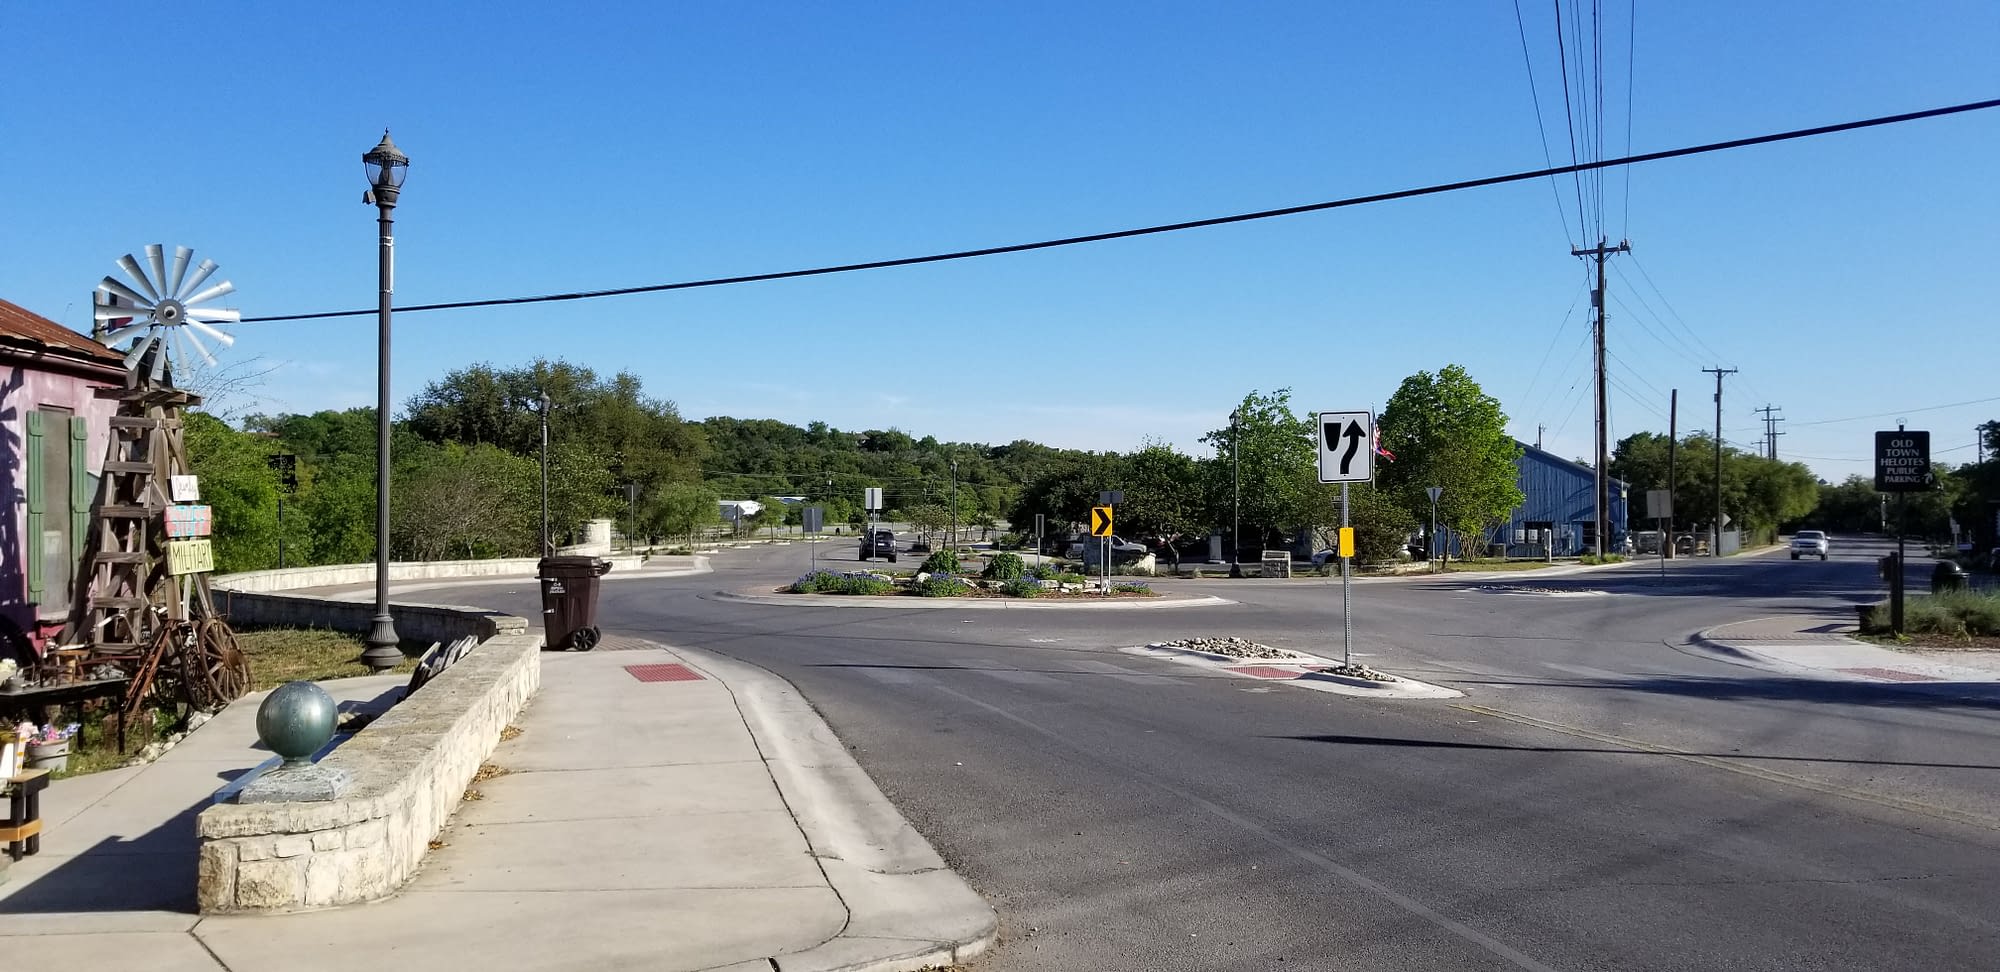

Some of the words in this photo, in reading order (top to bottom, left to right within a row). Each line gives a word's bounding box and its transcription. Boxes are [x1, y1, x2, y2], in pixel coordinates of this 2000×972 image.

[1891, 439, 1913, 447] OLD
[1885, 448, 1920, 457] TOWN
[1880, 458, 1925, 466] HELOTES
[1886, 467, 1920, 475] PUBLIC
[1884, 475, 1921, 483] PARKING
[172, 543, 213, 572] MILITARY
